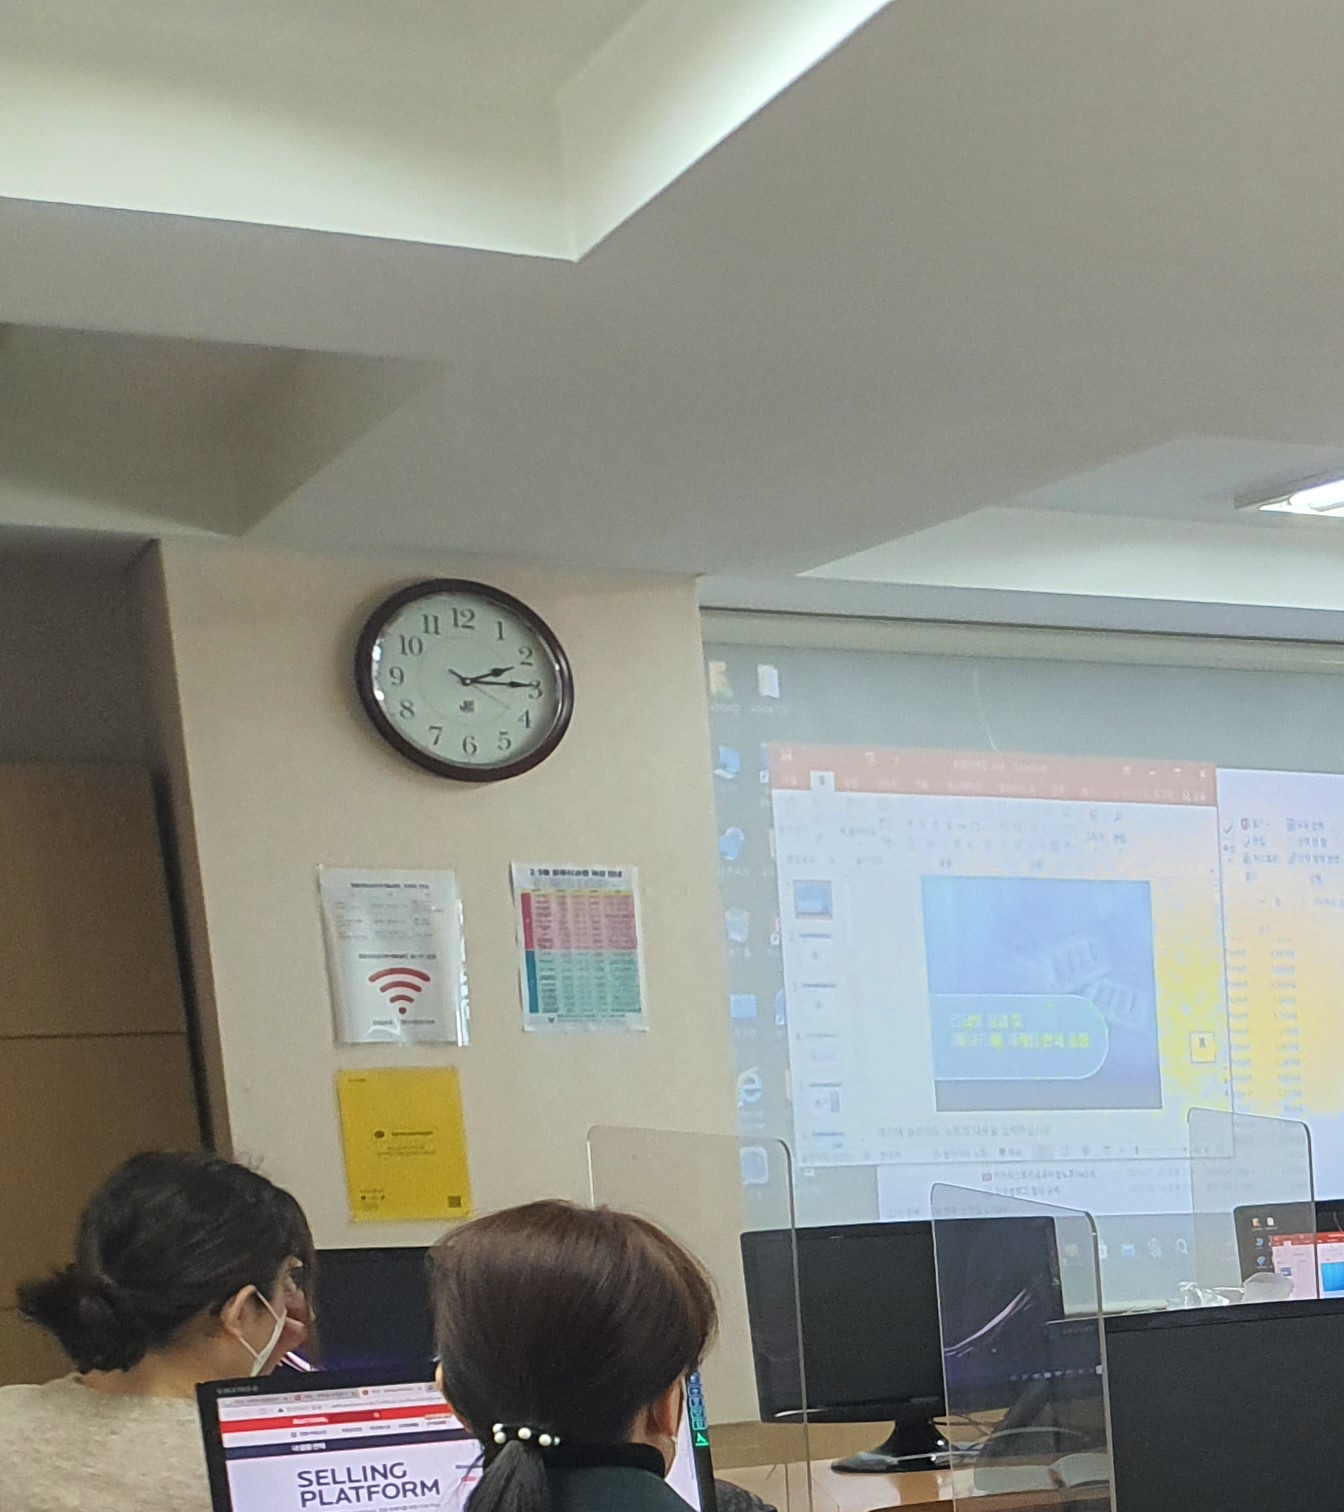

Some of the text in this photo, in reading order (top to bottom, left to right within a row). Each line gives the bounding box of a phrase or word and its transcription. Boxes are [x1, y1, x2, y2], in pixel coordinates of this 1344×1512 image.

[423, 614, 441, 636] 11
[452, 607, 476, 629] 12
[497, 621, 504, 641] 1
[399, 635, 423, 657] 10
[518, 647, 533, 666] 2
[389, 666, 404, 686] 9
[528, 679, 543, 700] 3
[400, 700, 415, 719] 8
[518, 709, 531, 728] 4
[428, 725, 443, 746] 7
[462, 735, 478, 756] 6
[498, 731, 512, 750] 5
[297, 1462, 407, 1488] SELLING
[300, 1478, 441, 1508] PLATFORM
